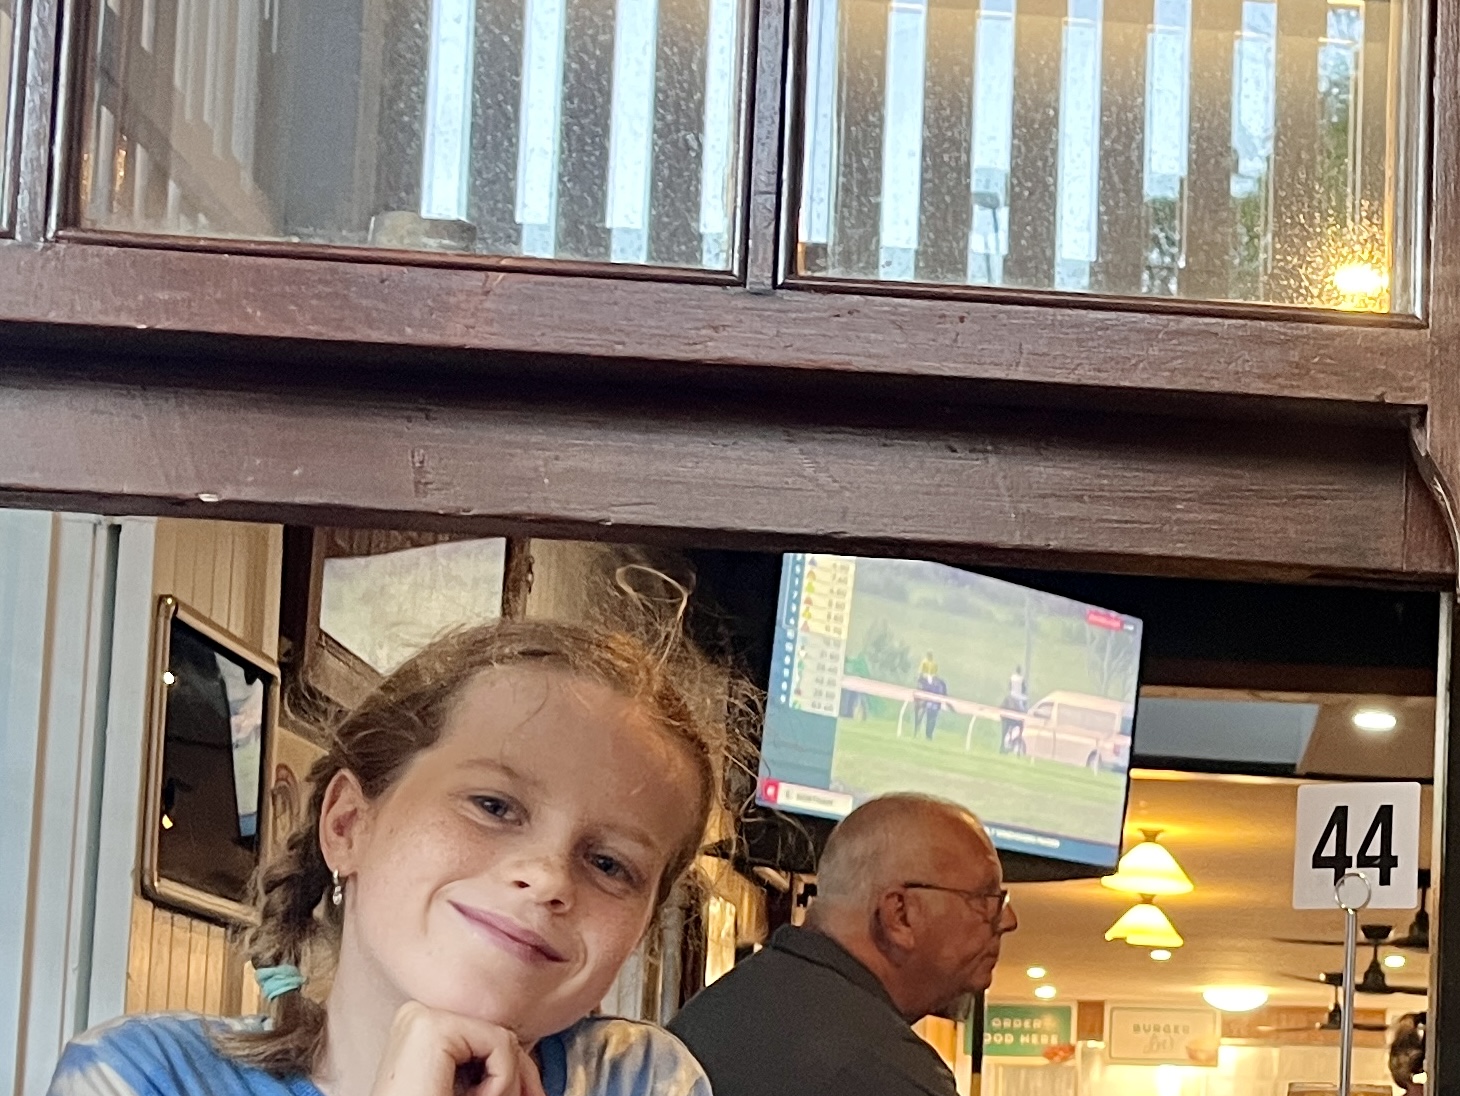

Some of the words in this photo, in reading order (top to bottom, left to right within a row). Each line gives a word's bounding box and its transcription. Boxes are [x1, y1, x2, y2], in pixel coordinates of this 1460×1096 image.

[1312, 804, 1399, 887] 44
[991, 1017, 1041, 1029] ORDER
[1132, 1023, 1190, 1034] BURGER
[982, 1033, 1014, 1044] OOD
[1020, 1033, 1058, 1045] HERE
